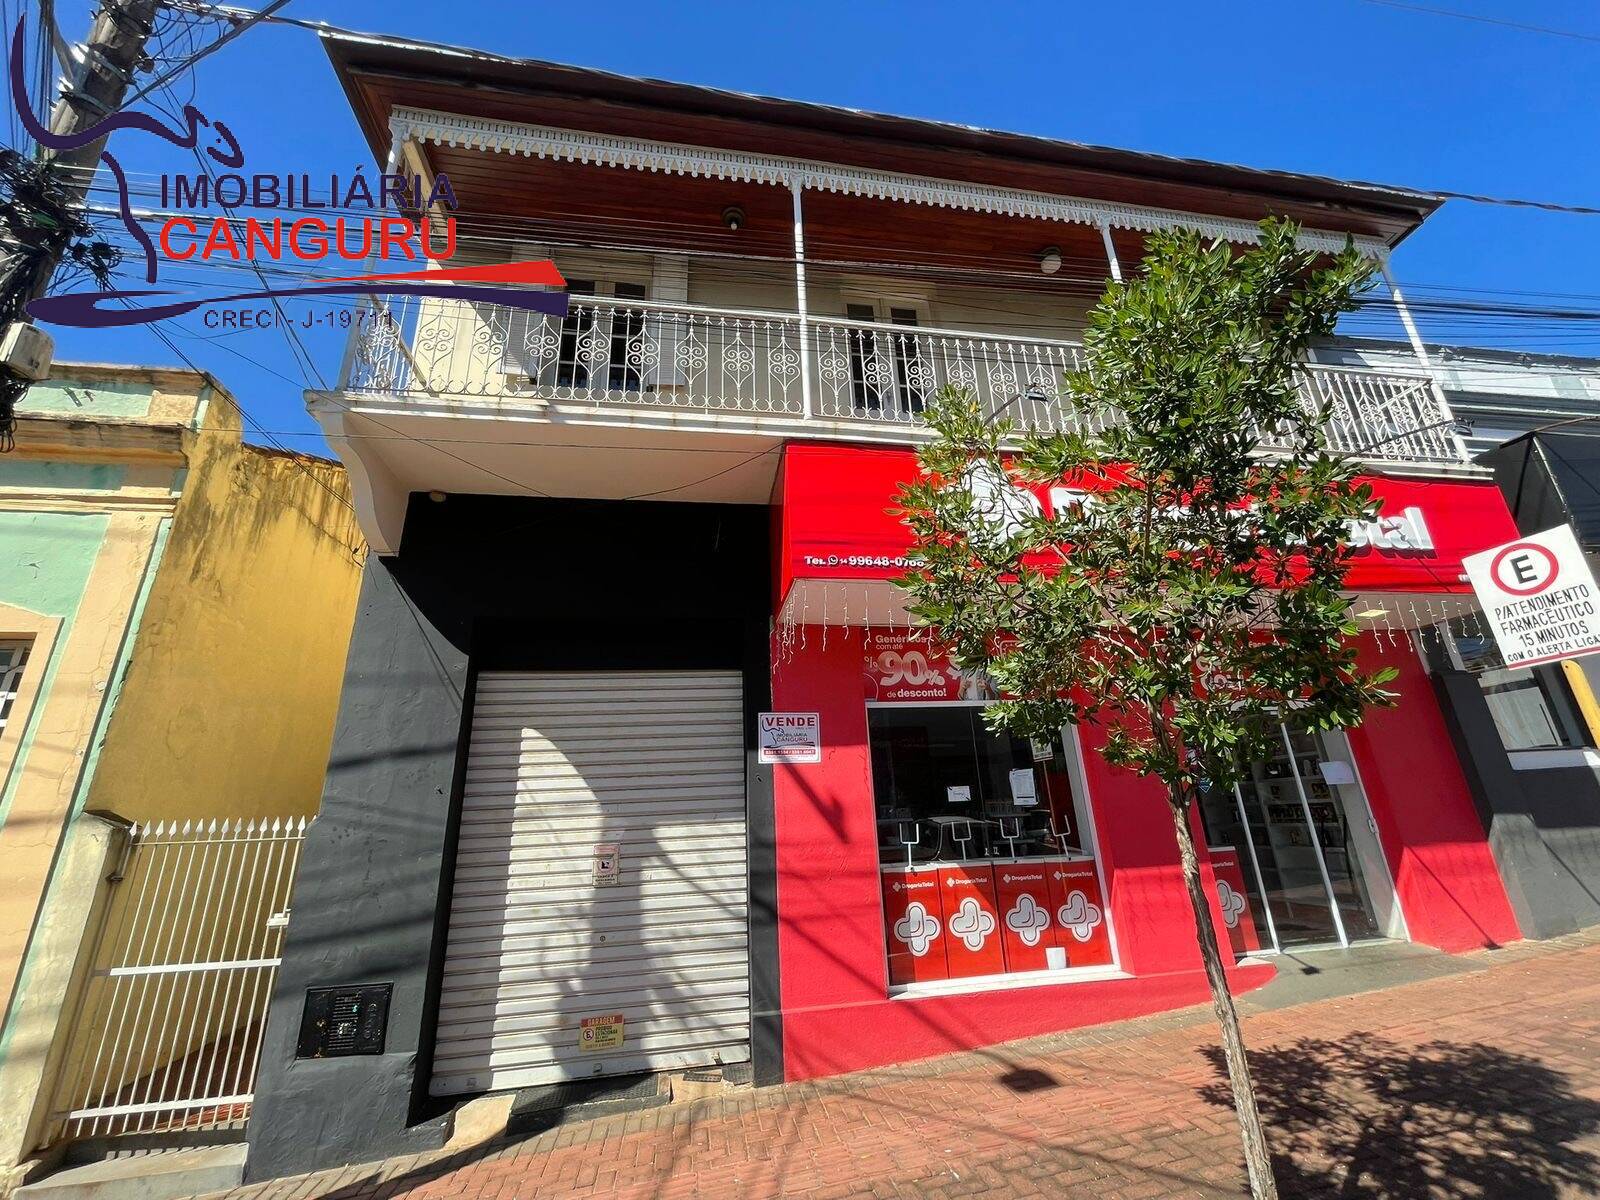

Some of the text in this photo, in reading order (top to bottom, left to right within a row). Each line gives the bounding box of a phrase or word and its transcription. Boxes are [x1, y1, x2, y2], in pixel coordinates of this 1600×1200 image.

[1509, 554, 1538, 584] E
[1495, 584, 1590, 620] P/ATENDIMENTO
[1500, 601, 1594, 636] FARMACÊUTICO
[1507, 634, 1600, 662] COM O ALERTA LIGA
[1519, 620, 1589, 648] 15 MINUTOS
[878, 651, 945, 686] 90%
[897, 688, 947, 698] desconto!
[765, 717, 815, 727] VENDE
